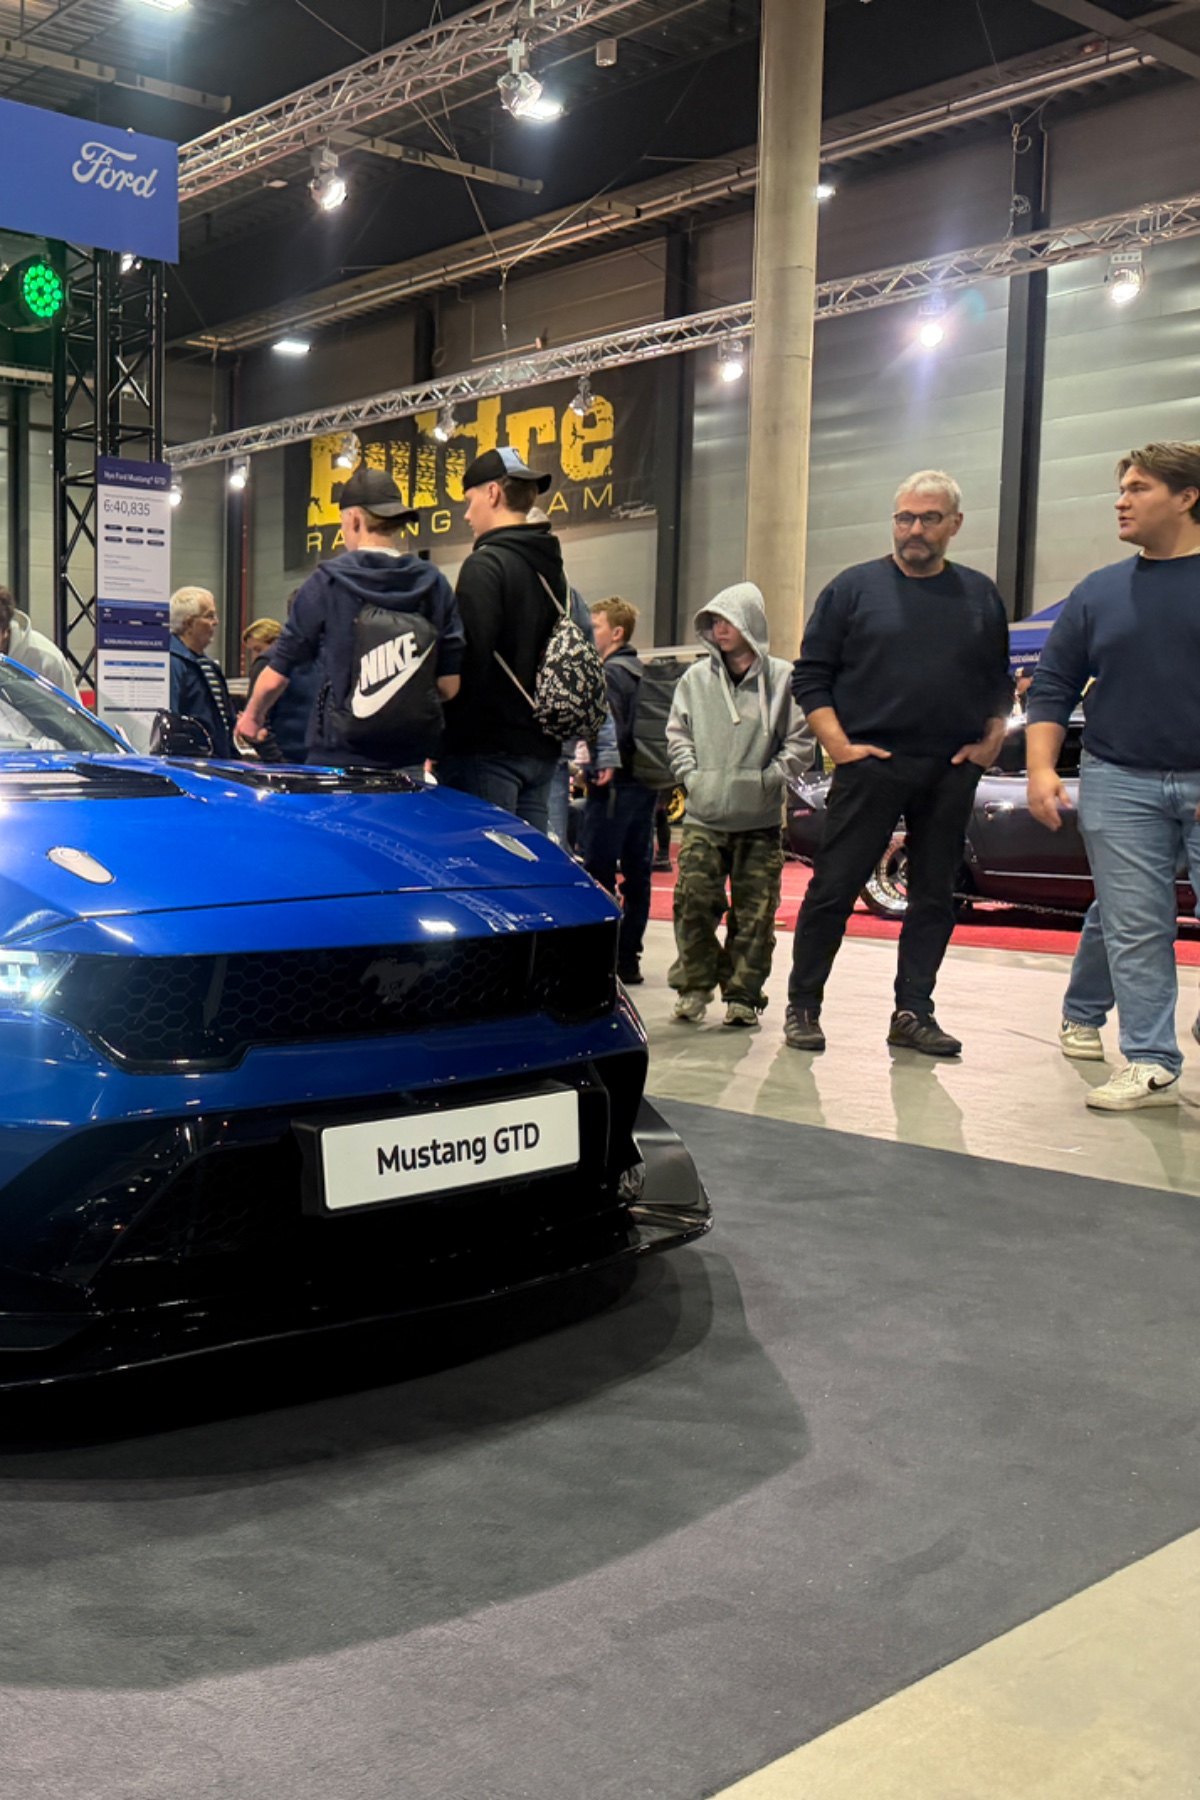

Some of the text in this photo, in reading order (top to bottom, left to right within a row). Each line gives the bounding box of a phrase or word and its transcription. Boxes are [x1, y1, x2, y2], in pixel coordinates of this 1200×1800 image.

[72, 142, 158, 198] Ford
[103, 499, 150, 516] 6:40,835
[306, 510, 452, 553] RANG
[360, 631, 421, 692] NIKE
[377, 1121, 540, 1175] Mustang GTD
